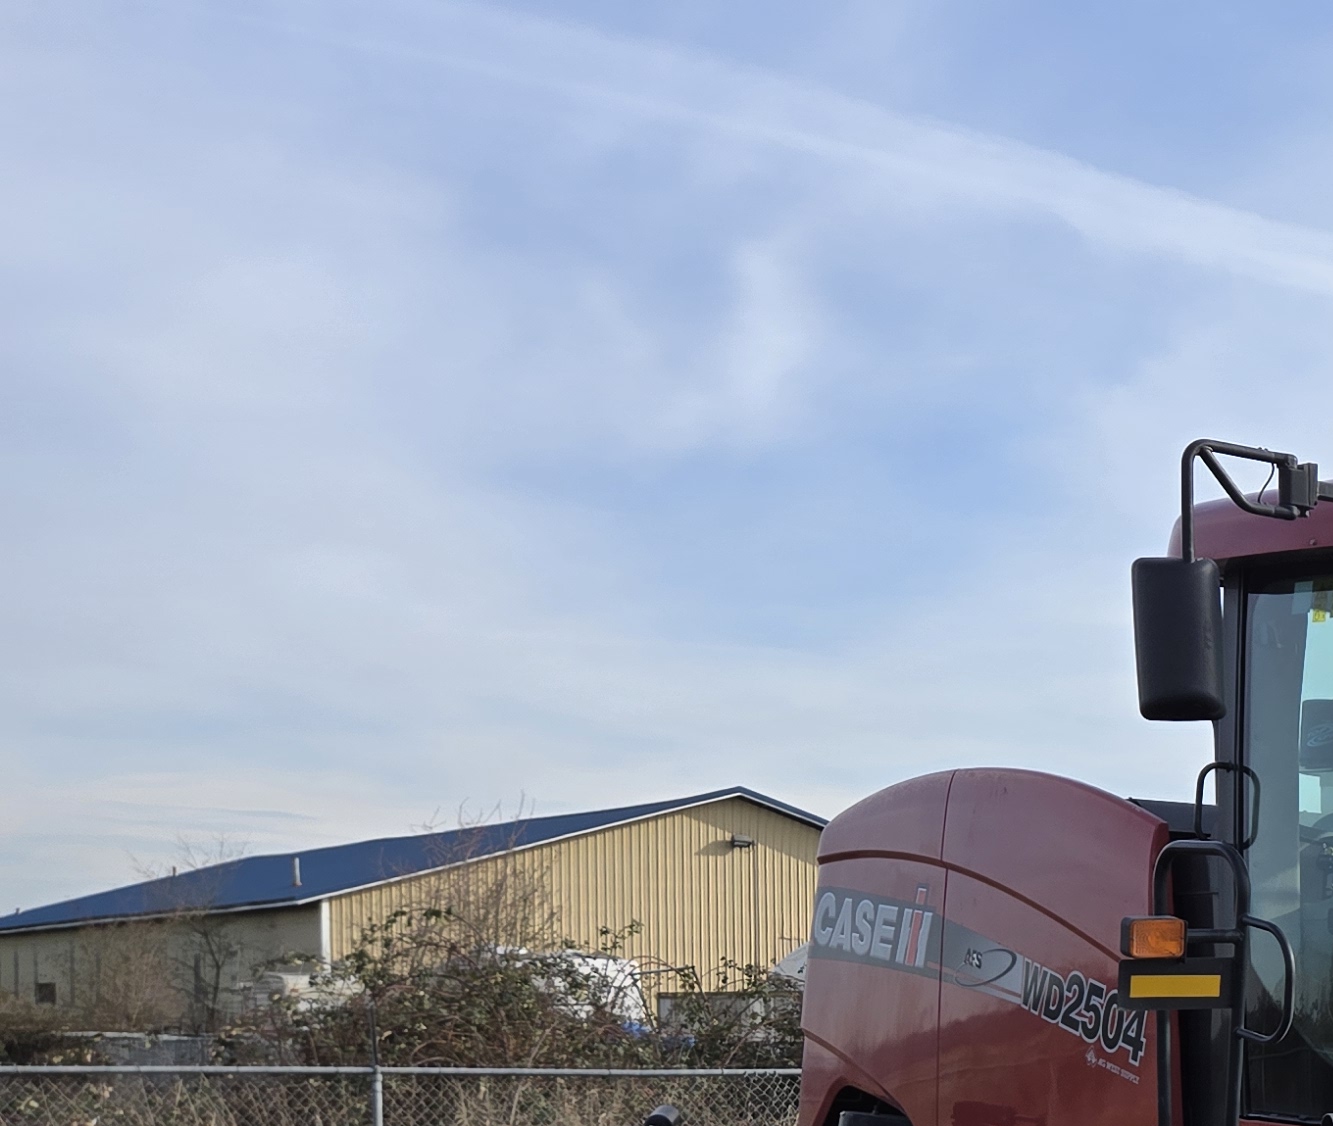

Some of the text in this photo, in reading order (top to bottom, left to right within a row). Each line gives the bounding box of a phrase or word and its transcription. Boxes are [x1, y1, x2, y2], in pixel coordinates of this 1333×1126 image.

[814, 891, 899, 961] CASE
[963, 948, 983, 970] AFS
[1020, 957, 1148, 1067] WD2504
